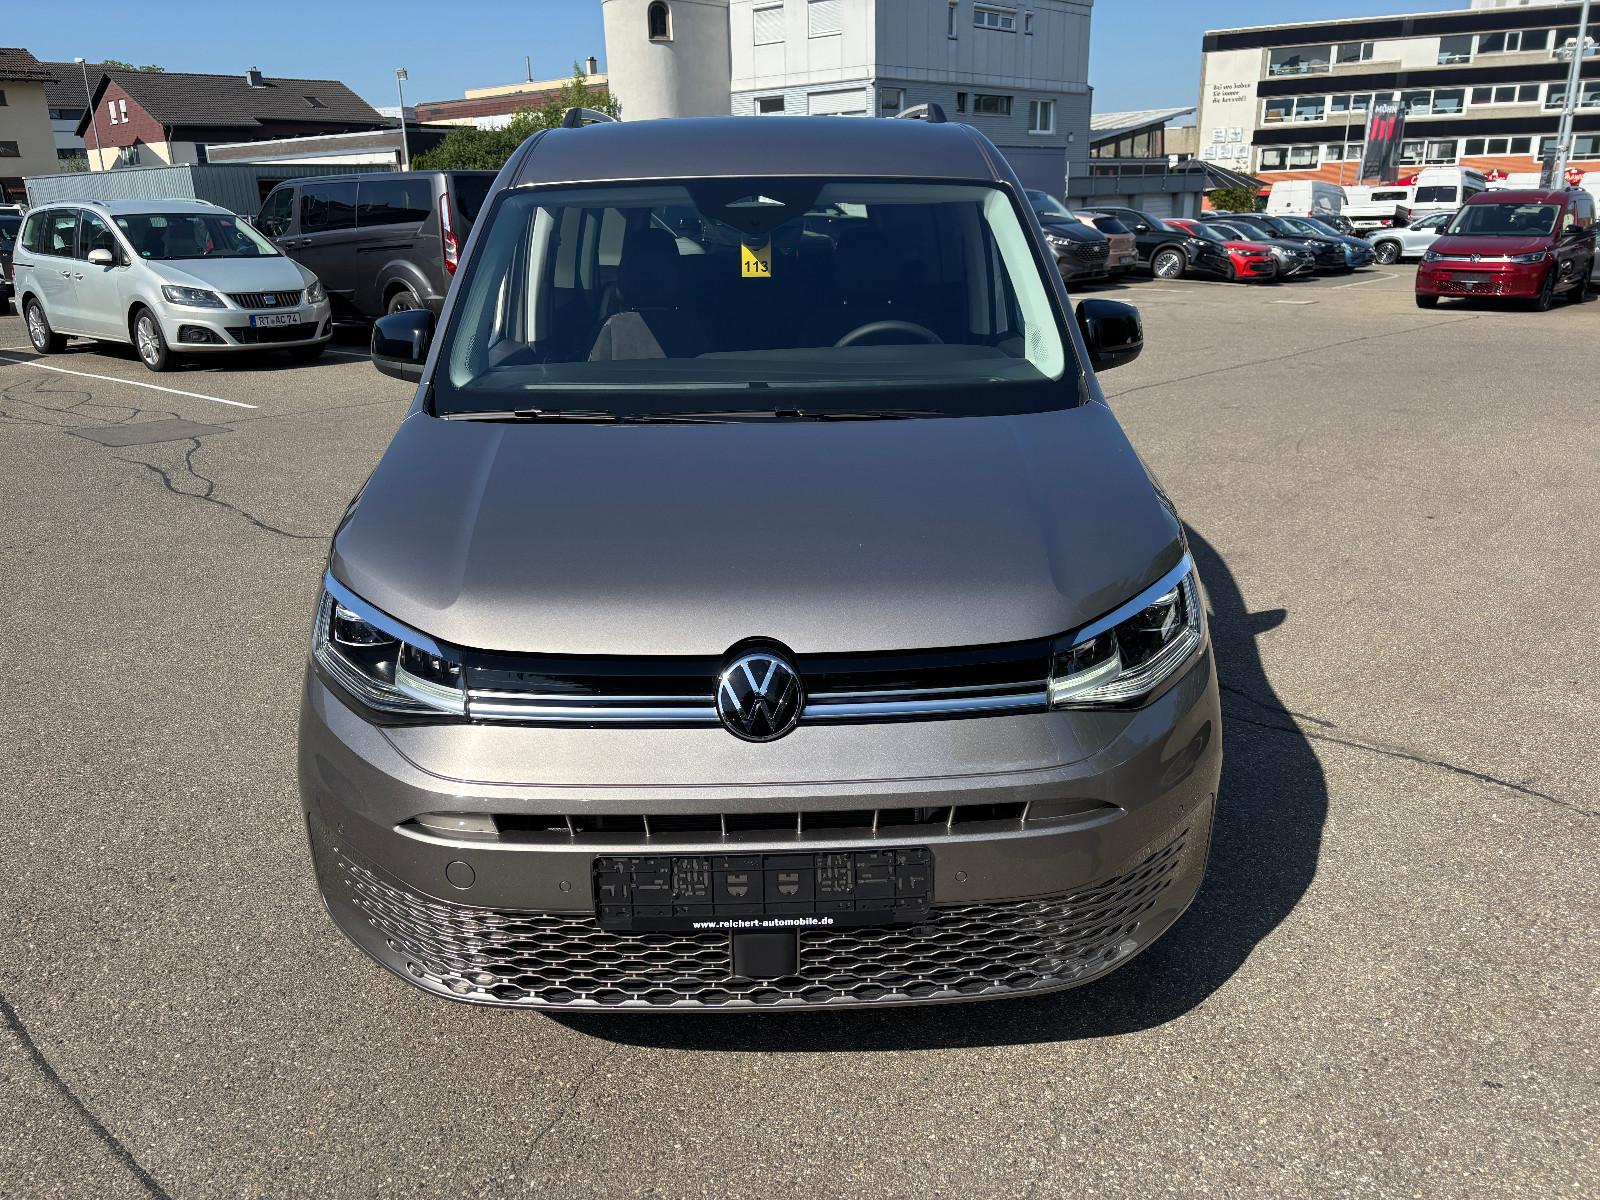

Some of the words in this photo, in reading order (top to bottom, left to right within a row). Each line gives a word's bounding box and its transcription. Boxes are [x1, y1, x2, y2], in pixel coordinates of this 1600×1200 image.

[744, 260, 769, 273] 113
[258, 316, 270, 326] RT
[692, 916, 835, 929] www.reichert-automobile.de
